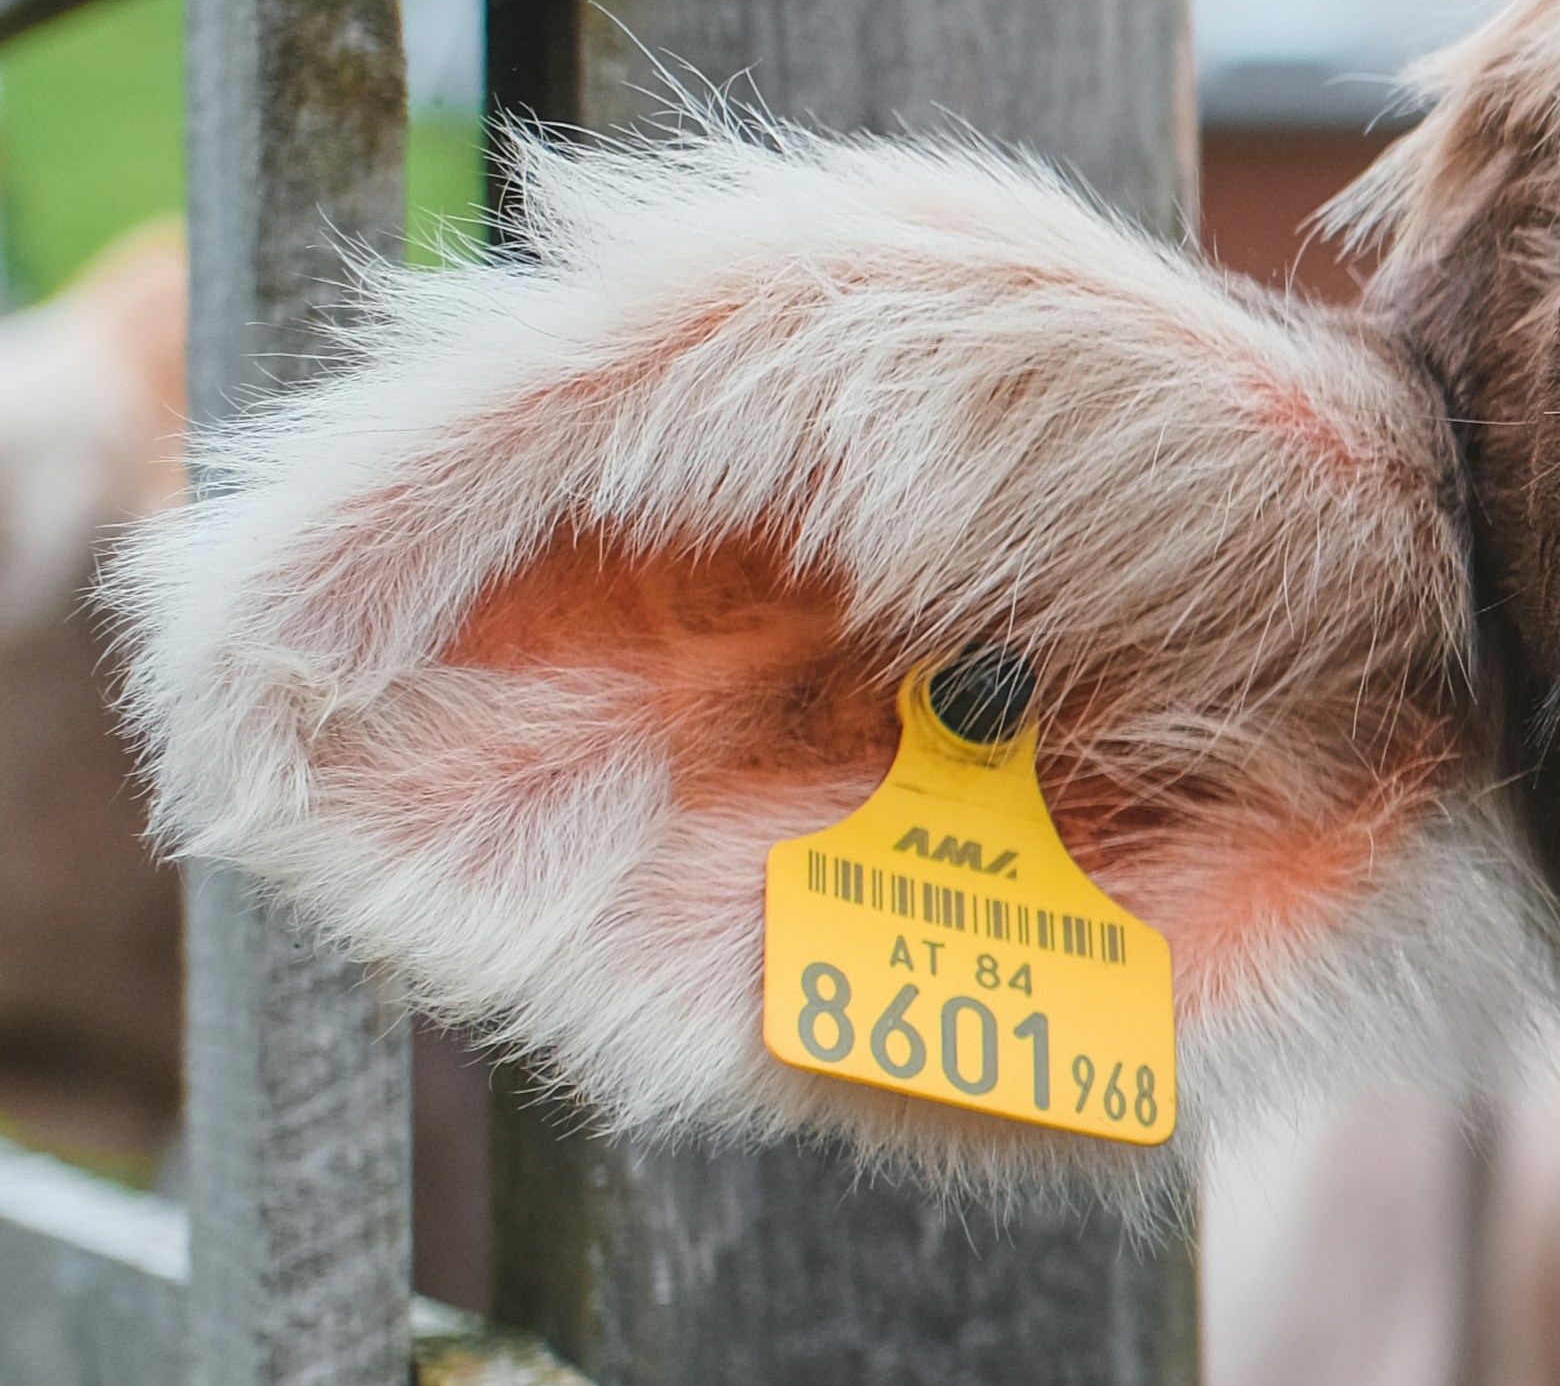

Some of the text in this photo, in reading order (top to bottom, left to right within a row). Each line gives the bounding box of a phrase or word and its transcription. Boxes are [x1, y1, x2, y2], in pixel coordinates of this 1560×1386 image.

[889, 935, 1034, 997] AT 84
[797, 961, 1158, 1128] 8601 968
